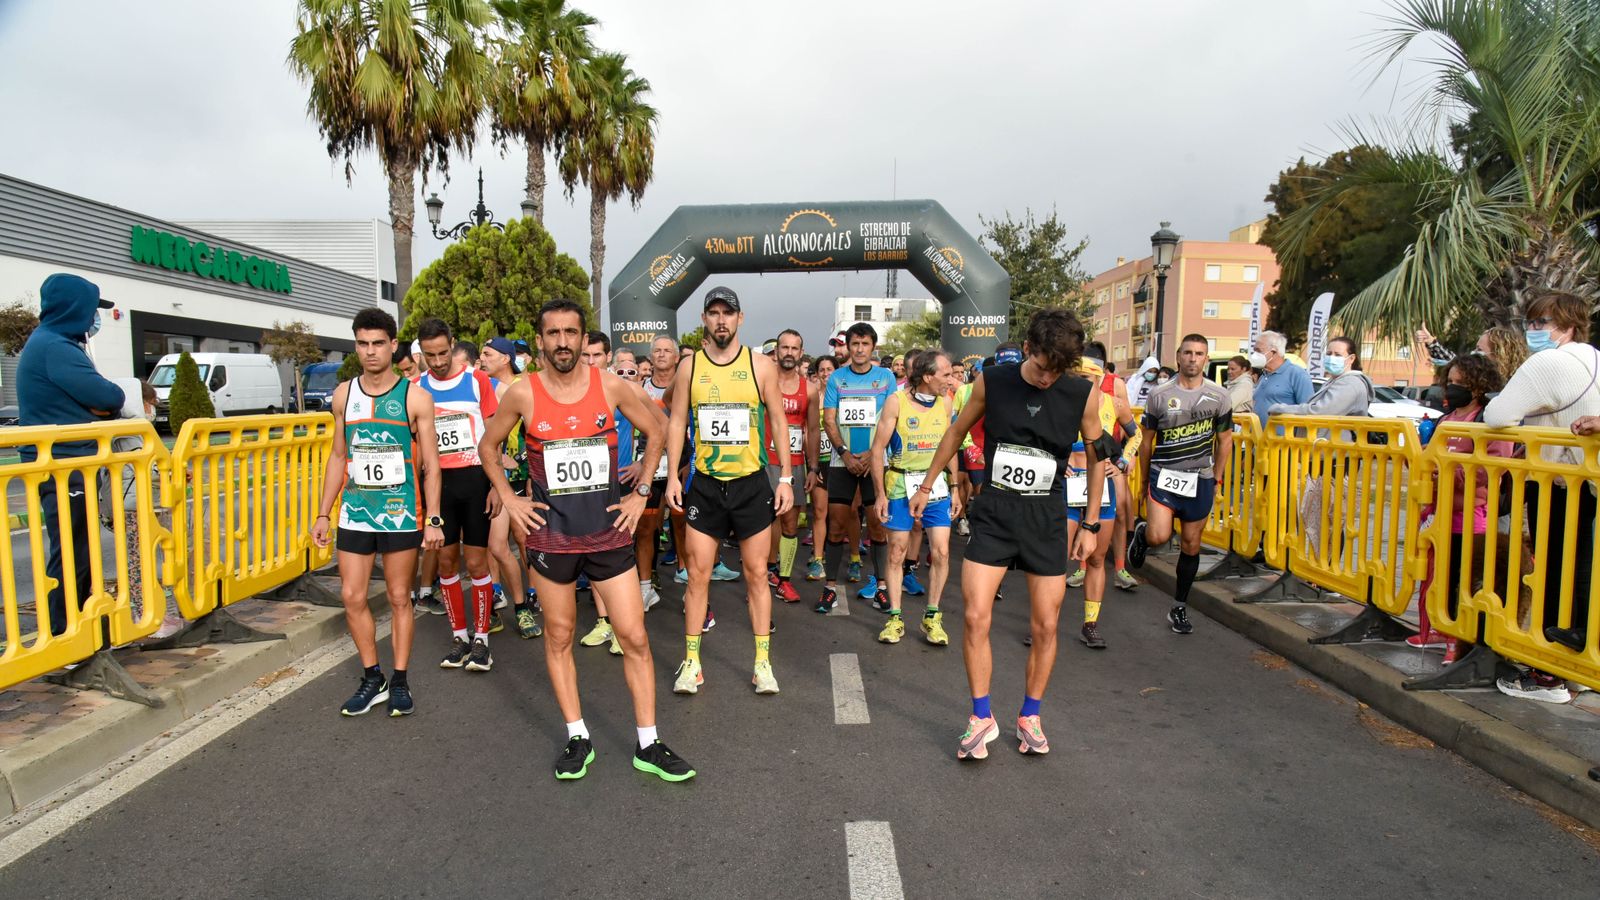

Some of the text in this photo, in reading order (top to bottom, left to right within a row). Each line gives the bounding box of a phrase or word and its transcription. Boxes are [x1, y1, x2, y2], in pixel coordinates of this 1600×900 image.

[860, 222, 911, 237] ESTRECHO DE
[737, 236, 755, 254] BTT
[763, 230, 852, 256] ALCORNOCALES
[864, 237, 907, 250] GIBRALTAR
[131, 225, 293, 295] MERCADONA
[863, 250, 908, 261] LOS BARRIOS
[923, 246, 965, 284] ALCORNOCALES
[648, 253, 686, 297] ALCORNOCALES
[612, 321, 668, 332] LOS BARRIOS
[949, 314, 1006, 325] LOS BARRIOS
[621, 331, 656, 343] CÁDIZ
[960, 325, 996, 337] CÁDIZ
[845, 409, 865, 421] 285
[711, 420, 730, 436] 54
[364, 464, 383, 481] 16
[556, 460, 592, 482] 500
[1001, 465, 1036, 486] 289
[1164, 477, 1189, 492] 297
